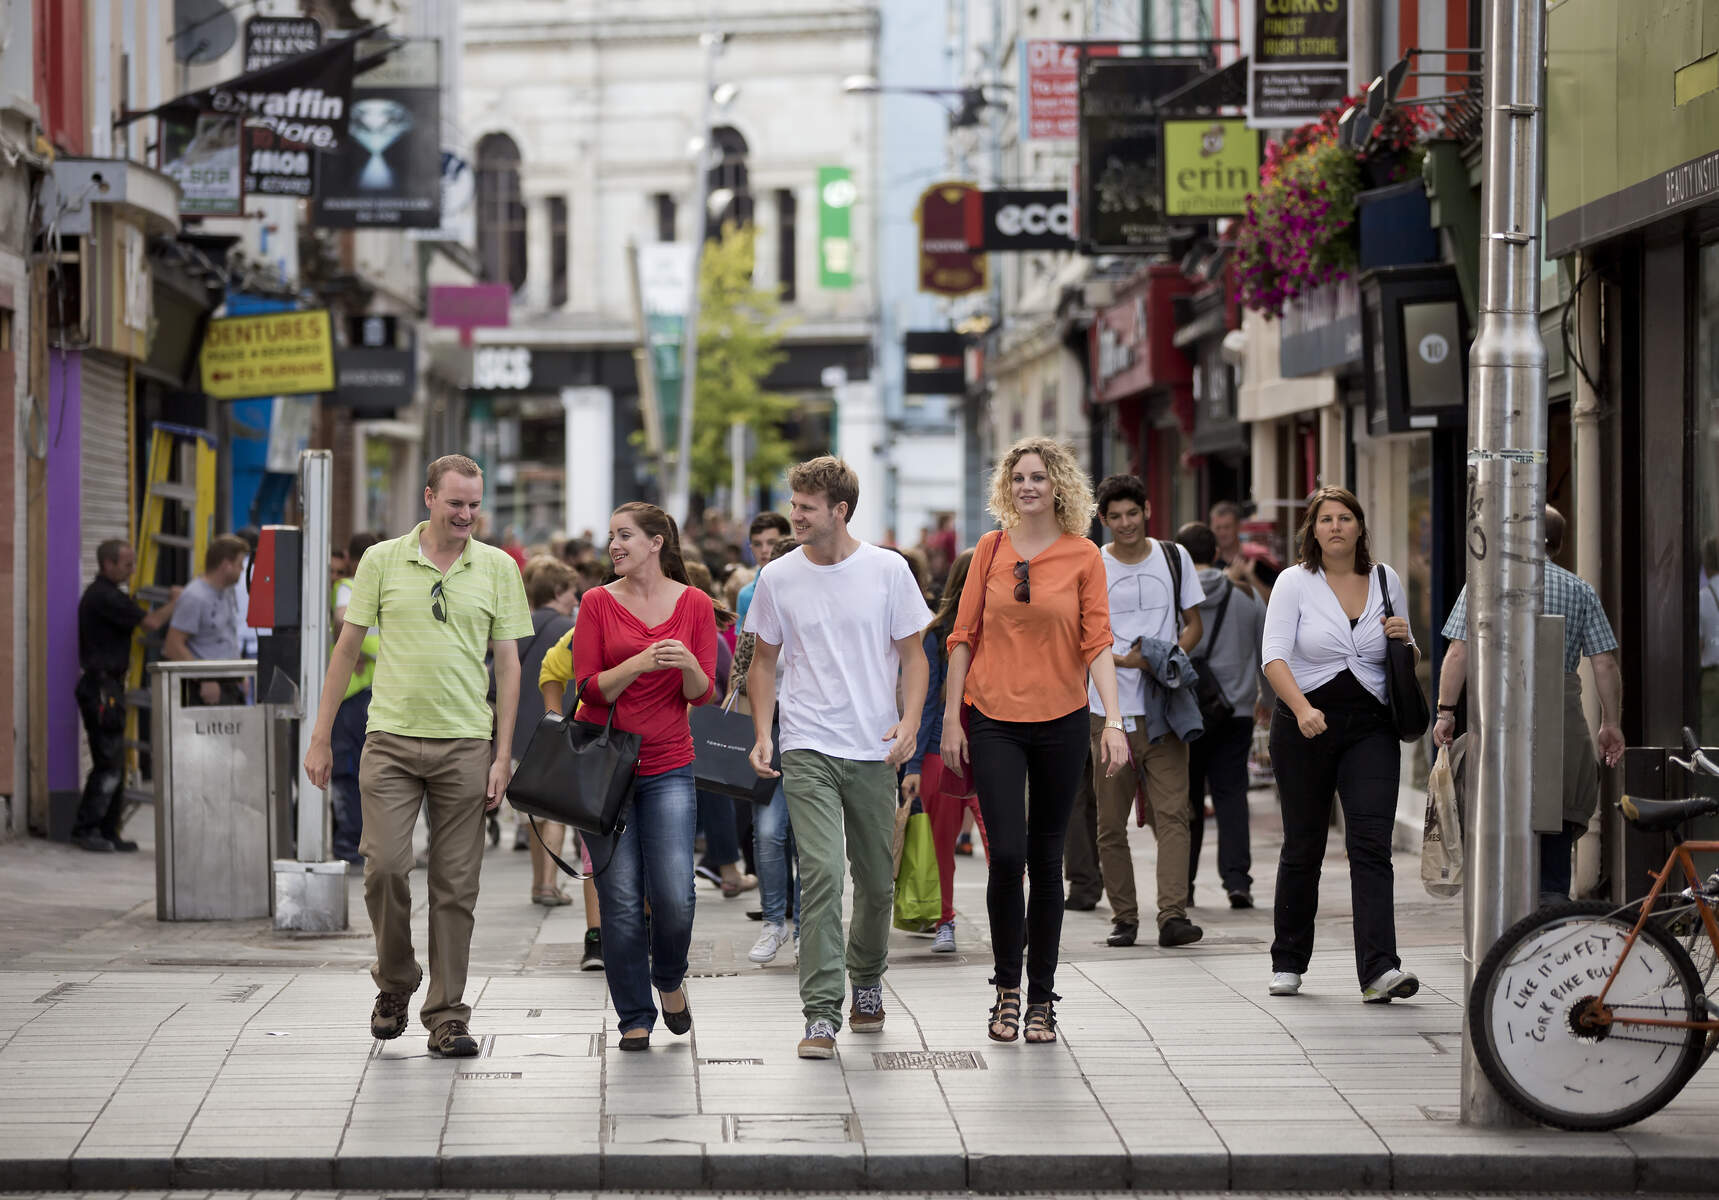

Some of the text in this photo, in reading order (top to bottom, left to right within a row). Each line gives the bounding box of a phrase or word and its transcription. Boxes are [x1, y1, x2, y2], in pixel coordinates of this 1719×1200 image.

[1263, 17, 1306, 36] FINEST
[1263, 37, 1338, 57] IRISH STORE
[1176, 161, 1249, 193] erin
[1666, 166, 1694, 205] BEAUTY
[205, 318, 323, 348] DENTURES
[1426, 341, 1443, 360] 10
[195, 720, 240, 736] Litter
[1513, 978, 1539, 1009] LIKE
[1550, 973, 1584, 1002] BIKE
